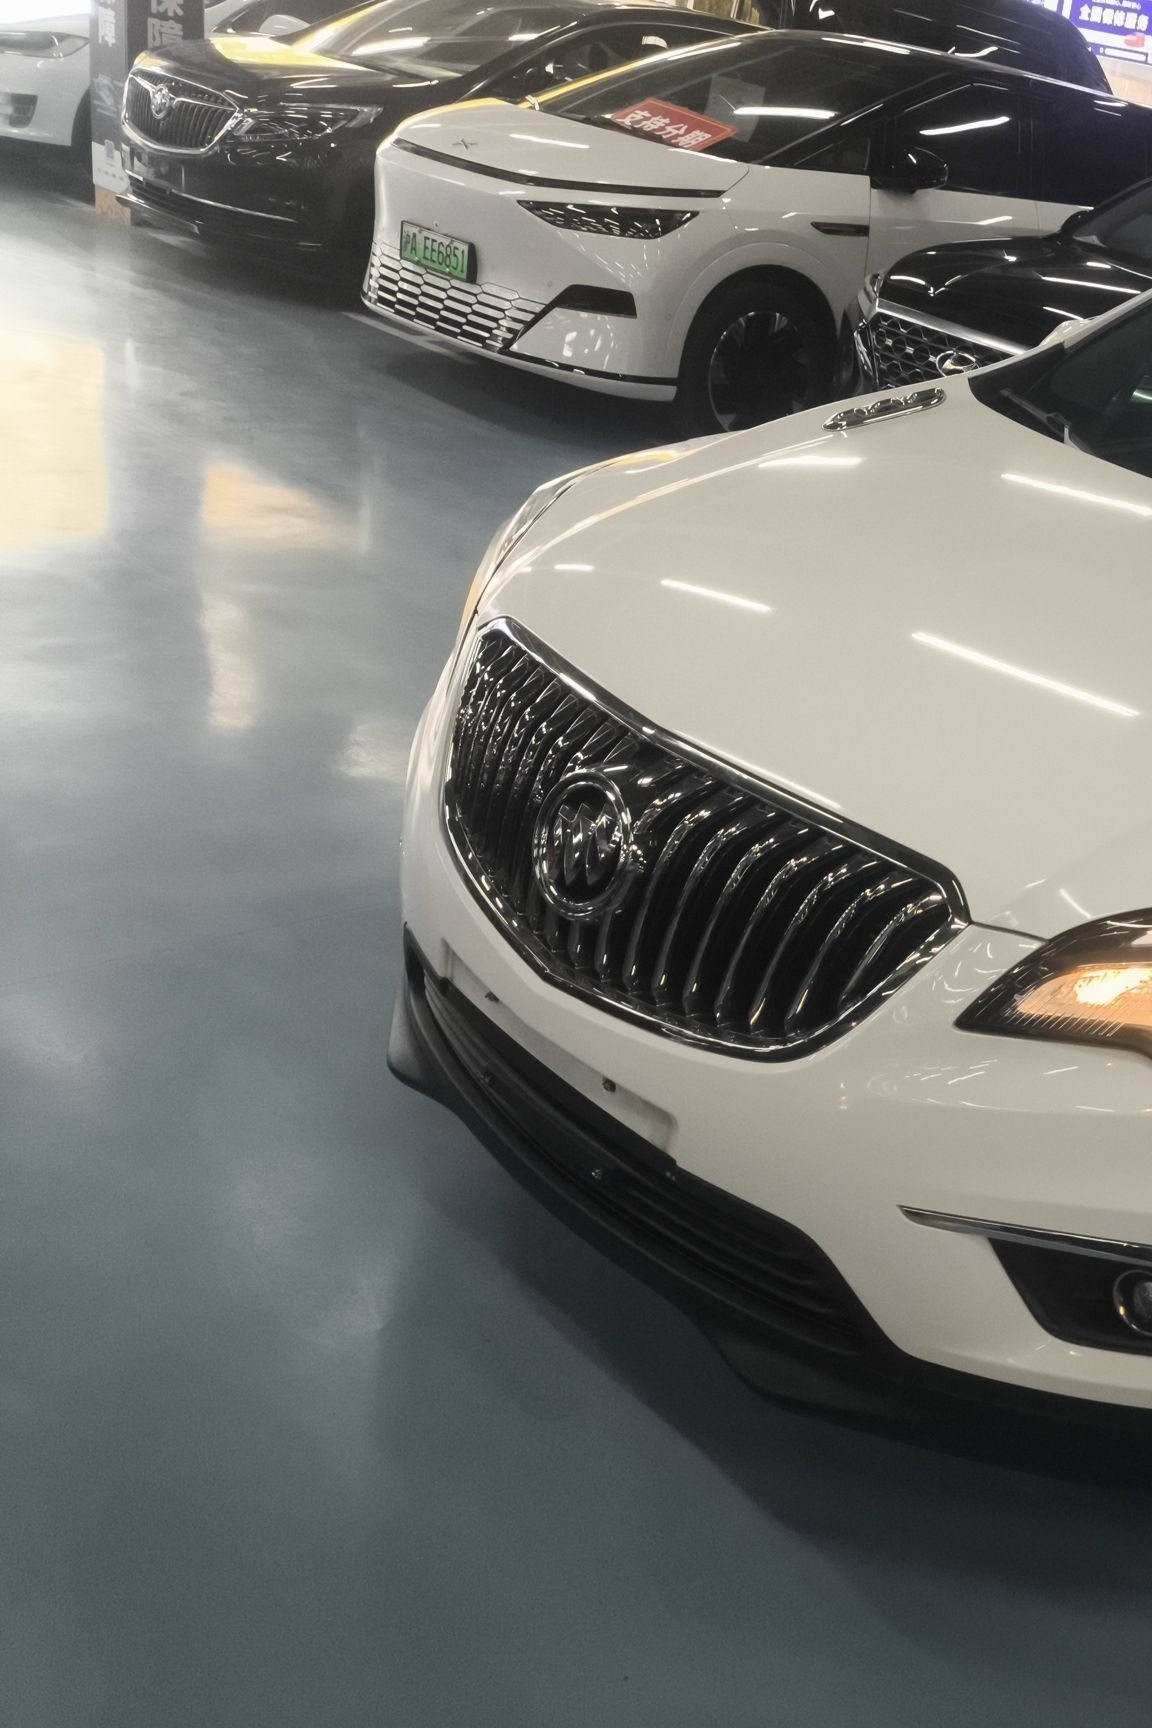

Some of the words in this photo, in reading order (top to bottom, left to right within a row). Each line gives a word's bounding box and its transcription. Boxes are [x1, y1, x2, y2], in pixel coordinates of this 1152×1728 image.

[609, 109, 713, 149] 支持分期
[423, 235, 465, 274] EE6851
